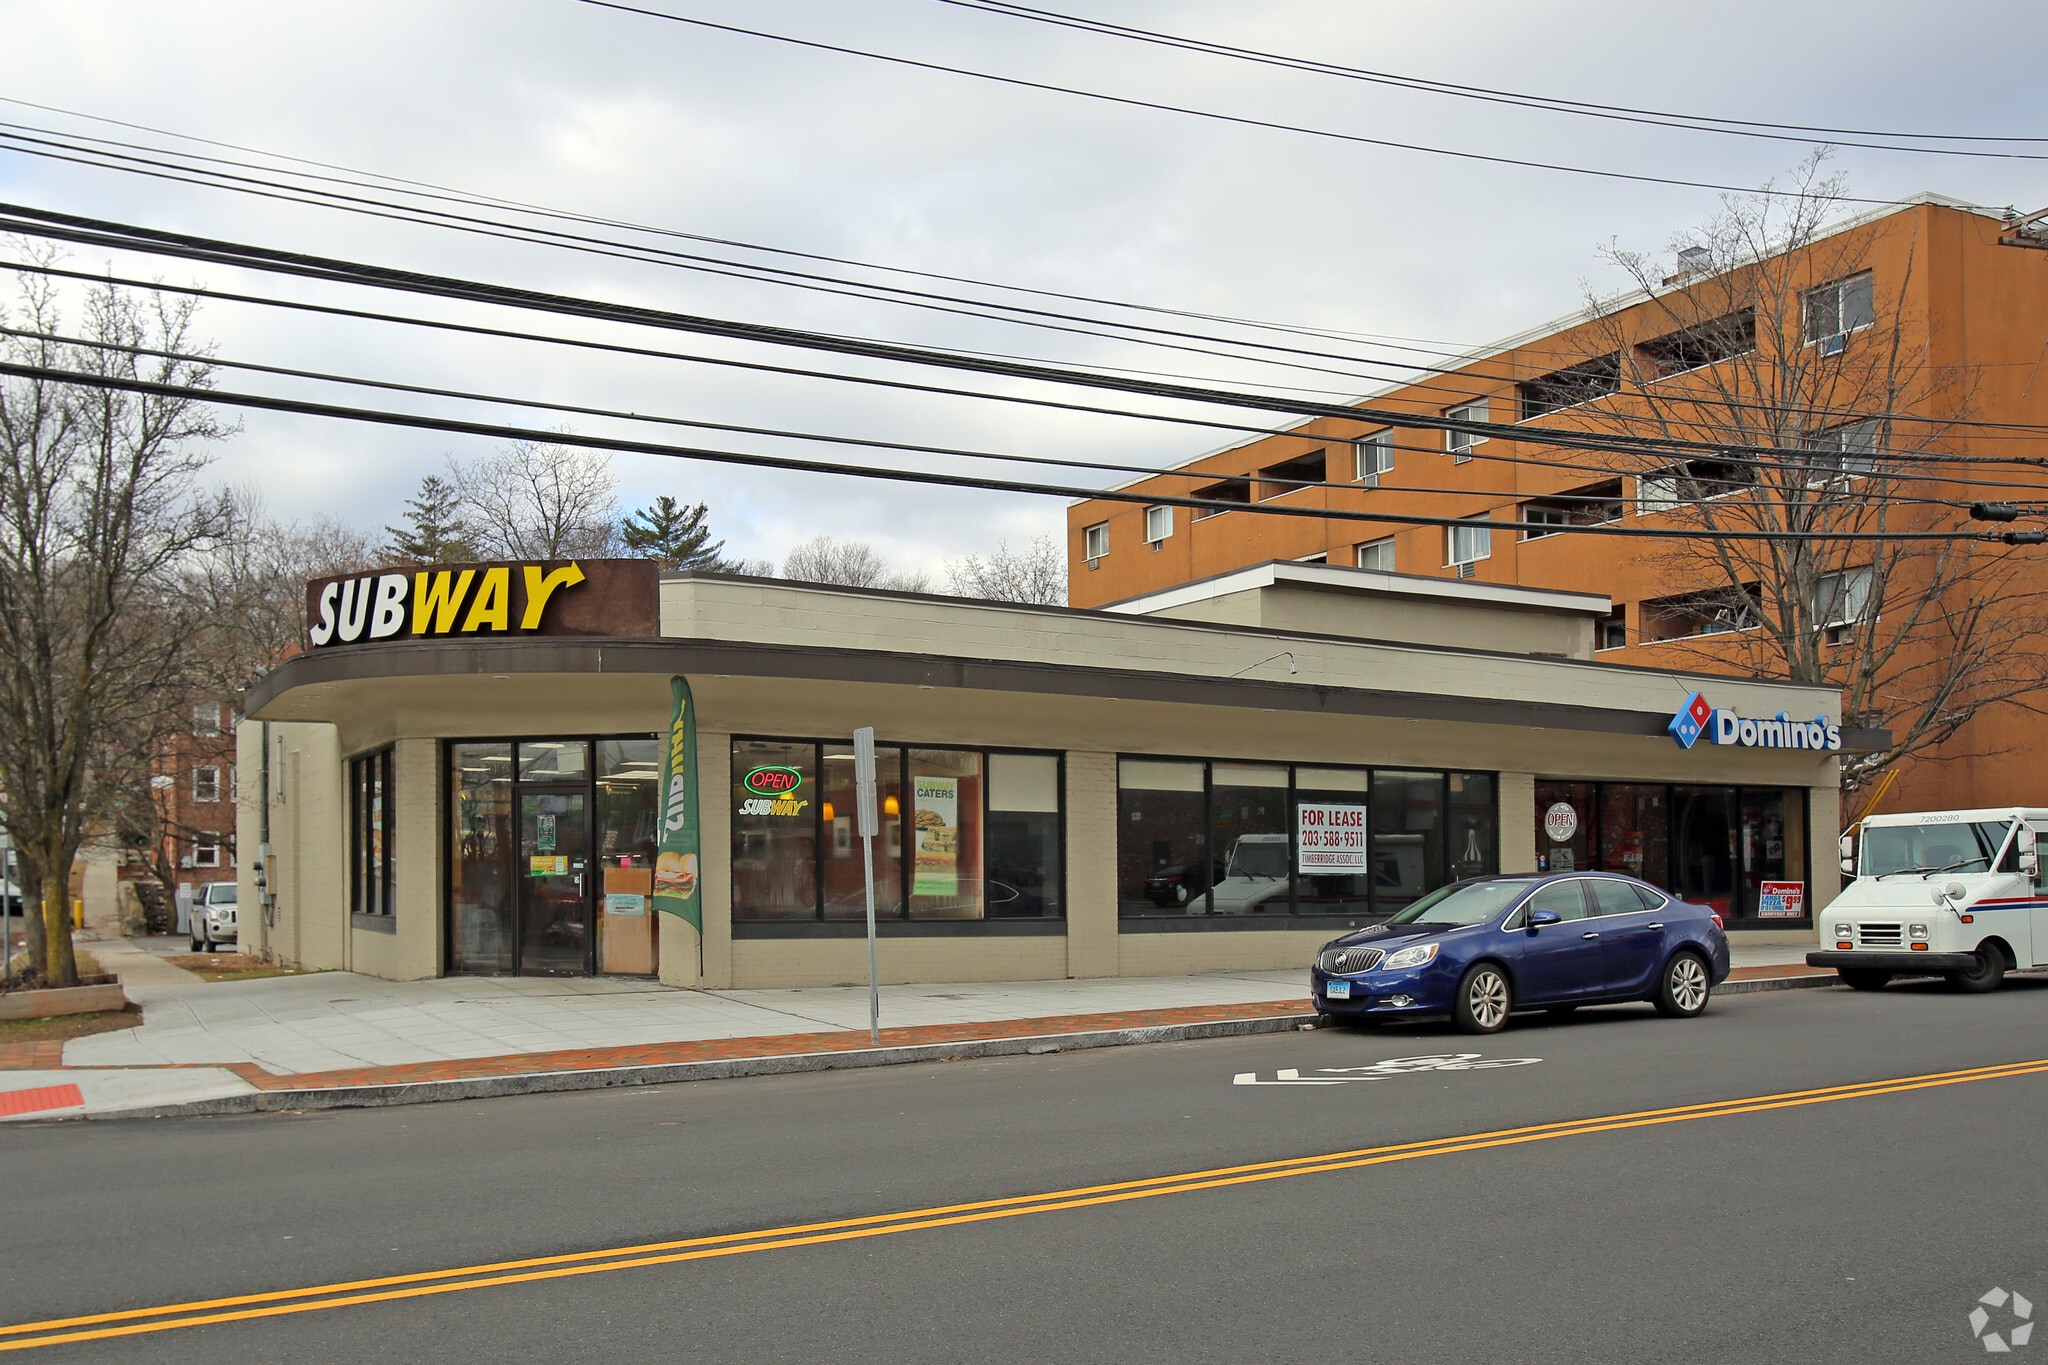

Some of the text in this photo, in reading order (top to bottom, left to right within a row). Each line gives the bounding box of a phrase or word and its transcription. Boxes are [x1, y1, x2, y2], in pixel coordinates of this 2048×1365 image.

[309, 561, 585, 646] SUBWAY
[1715, 708, 1842, 751] Domino's
[751, 771, 795, 789] OPEN
[916, 779, 954, 790] SUBWAY
[917, 788, 954, 799] CATERS
[738, 798, 809, 816] SUBWAY
[1302, 810, 1363, 827] FOR LEASE
[1547, 811, 1574, 828] OPEN
[1920, 814, 1960, 823] 7200280
[1302, 853, 1335, 864] TIMBERRIDGE
[1355, 854, 1364, 865] LLC
[1772, 887, 1801, 895] Domino's
